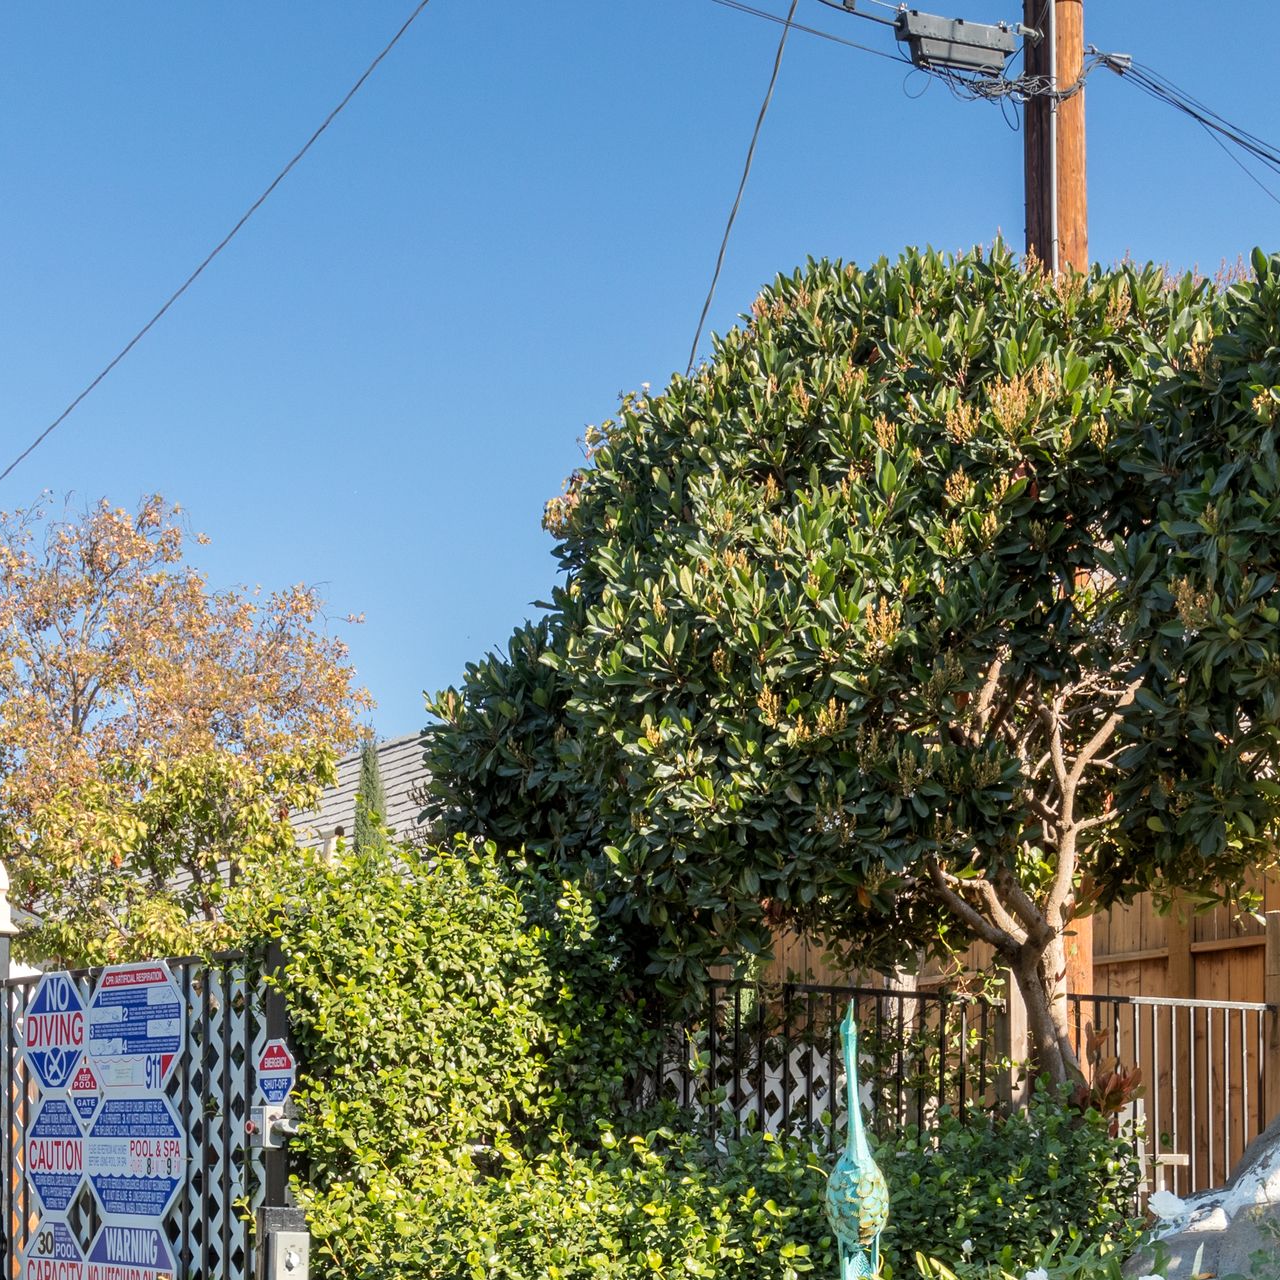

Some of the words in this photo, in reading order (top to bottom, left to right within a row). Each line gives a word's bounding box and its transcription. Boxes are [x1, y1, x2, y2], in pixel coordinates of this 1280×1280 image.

[46, 977, 69, 1011] NO
[123, 1008, 128, 1021] 2
[27, 1012, 83, 1047] DIVING
[122, 1040, 127, 1053] 4
[145, 1055, 161, 1089] 911
[264, 1079, 288, 1090] SHUT-OFF
[29, 1140, 82, 1170] CAUTION
[130, 1140, 153, 1157] POOL
[156, 1140, 161, 1157] &
[164, 1140, 180, 1157] SPA
[147, 1158, 151, 1175] 8
[167, 1158, 172, 1175] 9
[38, 1231, 54, 1255] 30
[55, 1243, 77, 1258] POOL
[105, 1227, 158, 1265] WARNING
